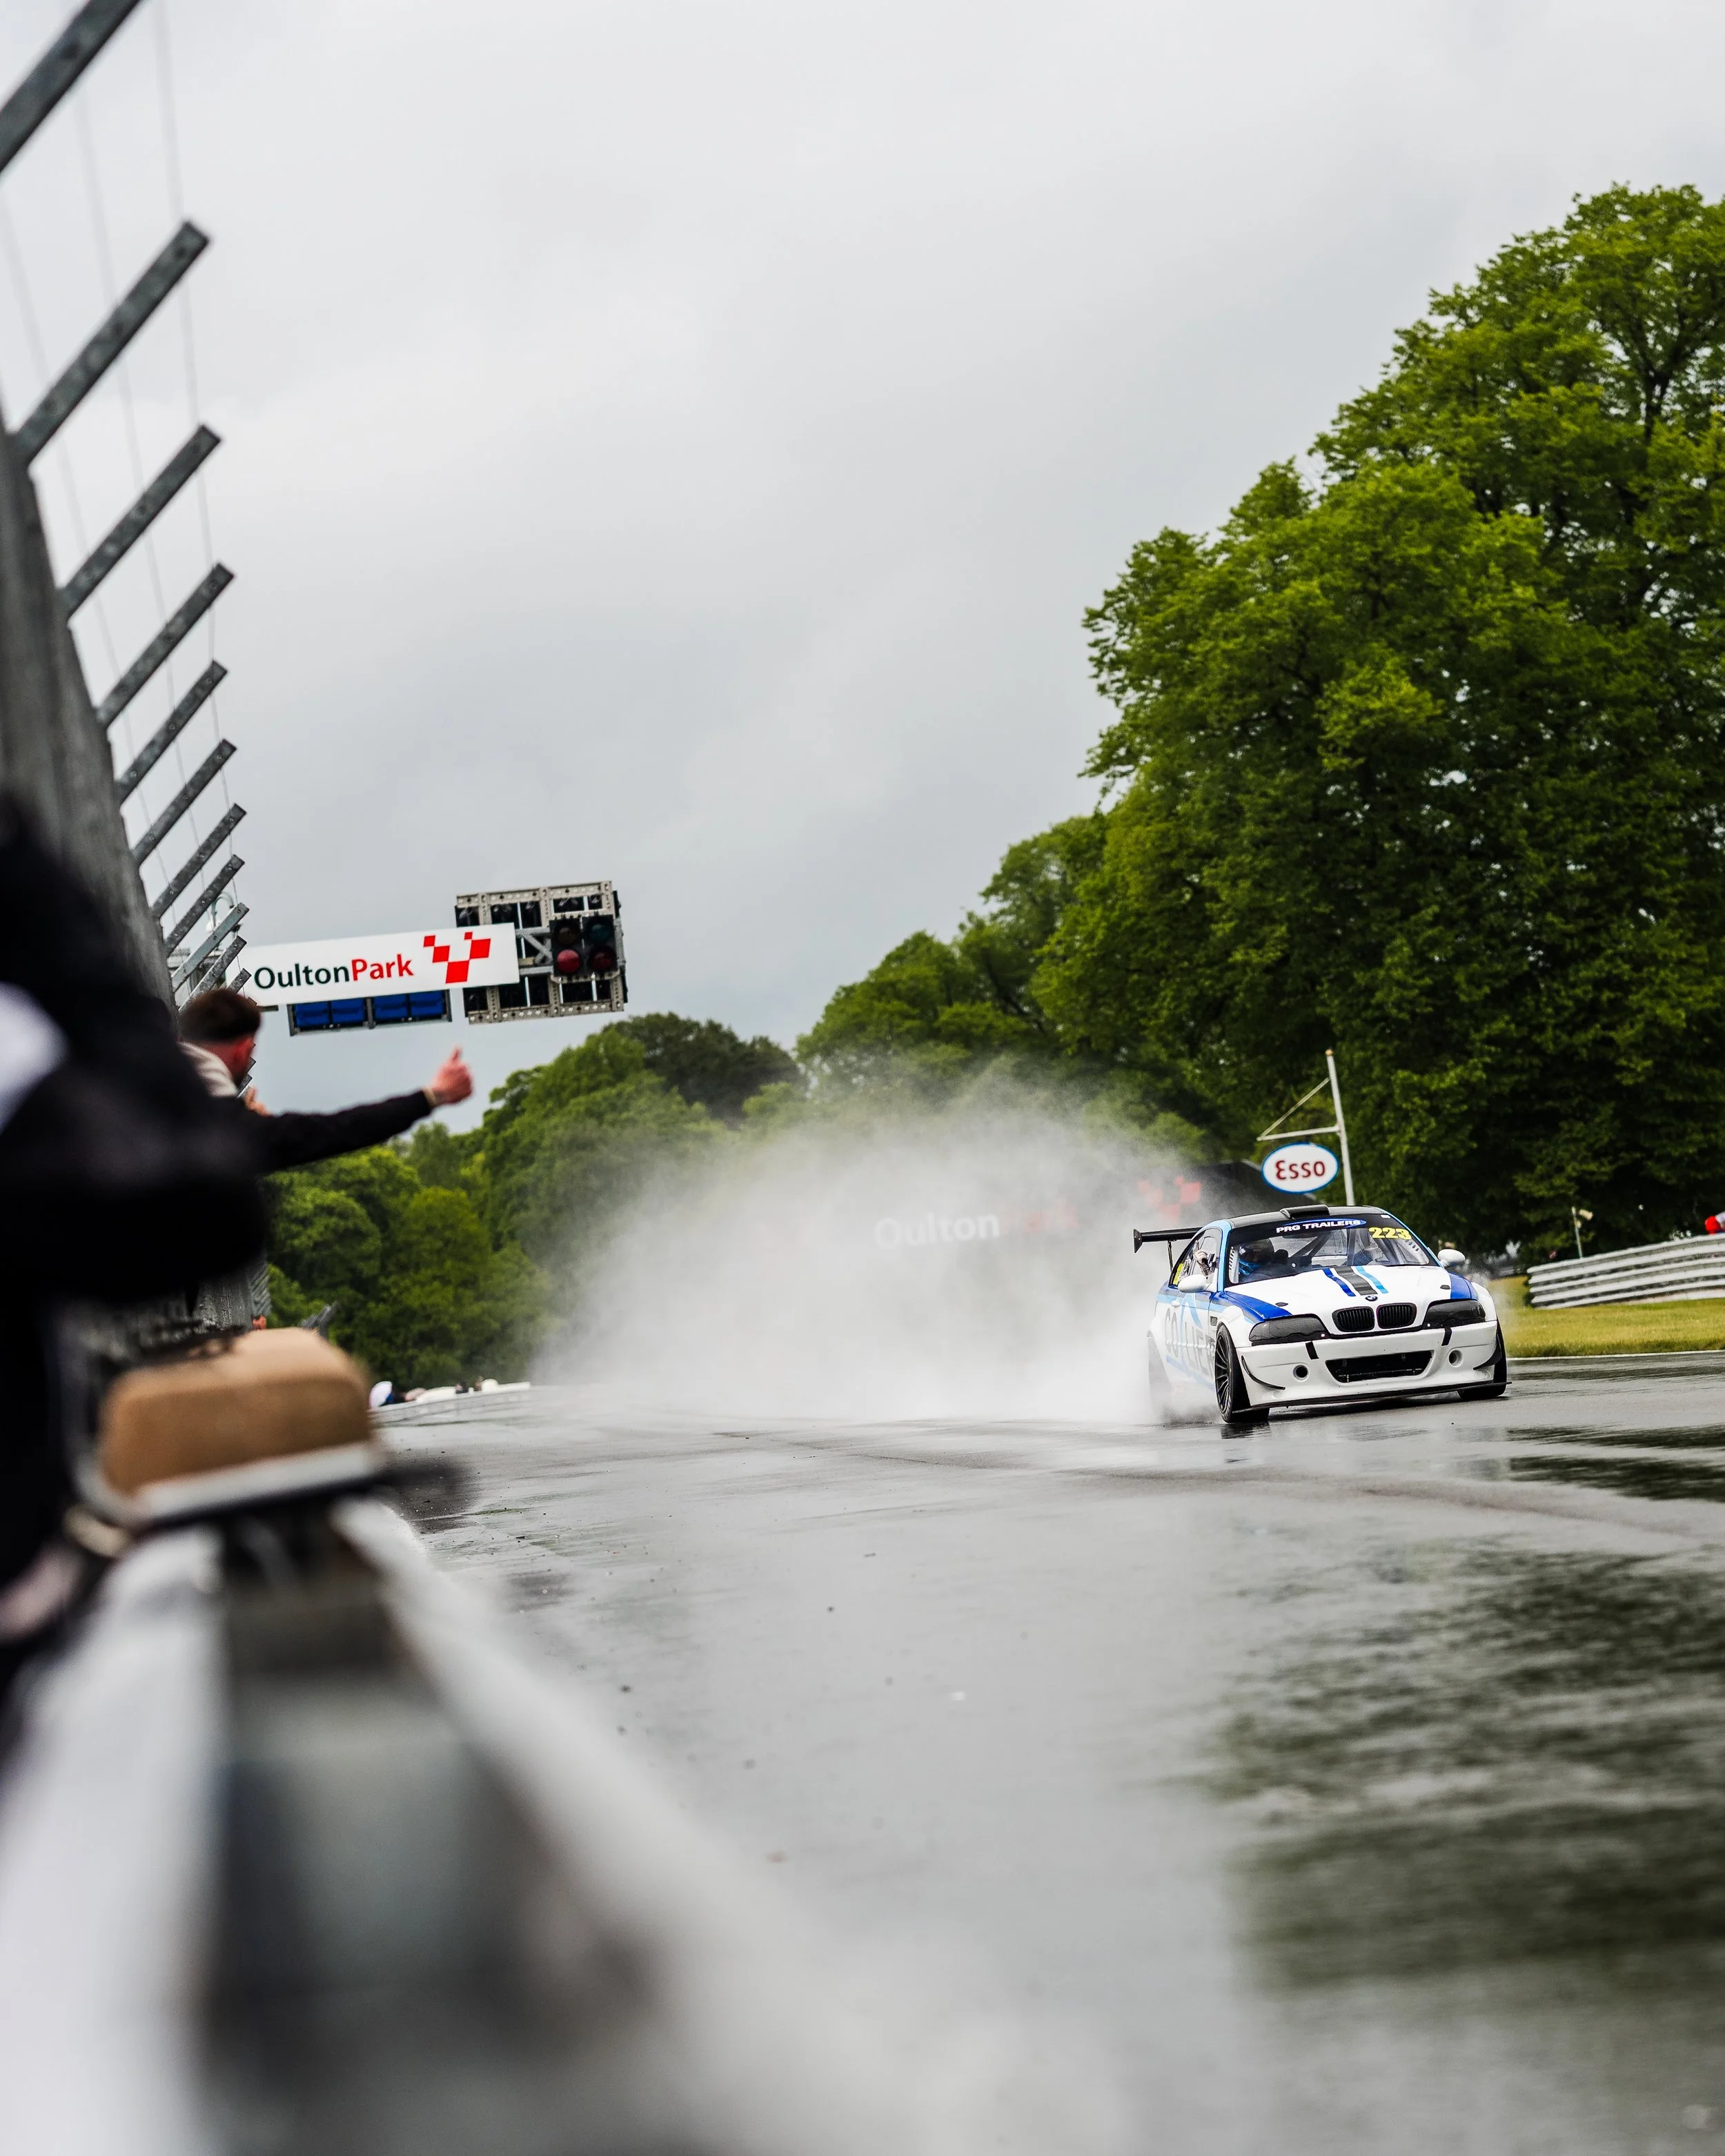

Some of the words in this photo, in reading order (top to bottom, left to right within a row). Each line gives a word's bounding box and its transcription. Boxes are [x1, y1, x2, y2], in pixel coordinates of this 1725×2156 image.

[253, 953, 414, 989] OultonPark
[1303, 1220, 1361, 1229] TRAILERS
[1368, 1227, 1412, 1240] 223
